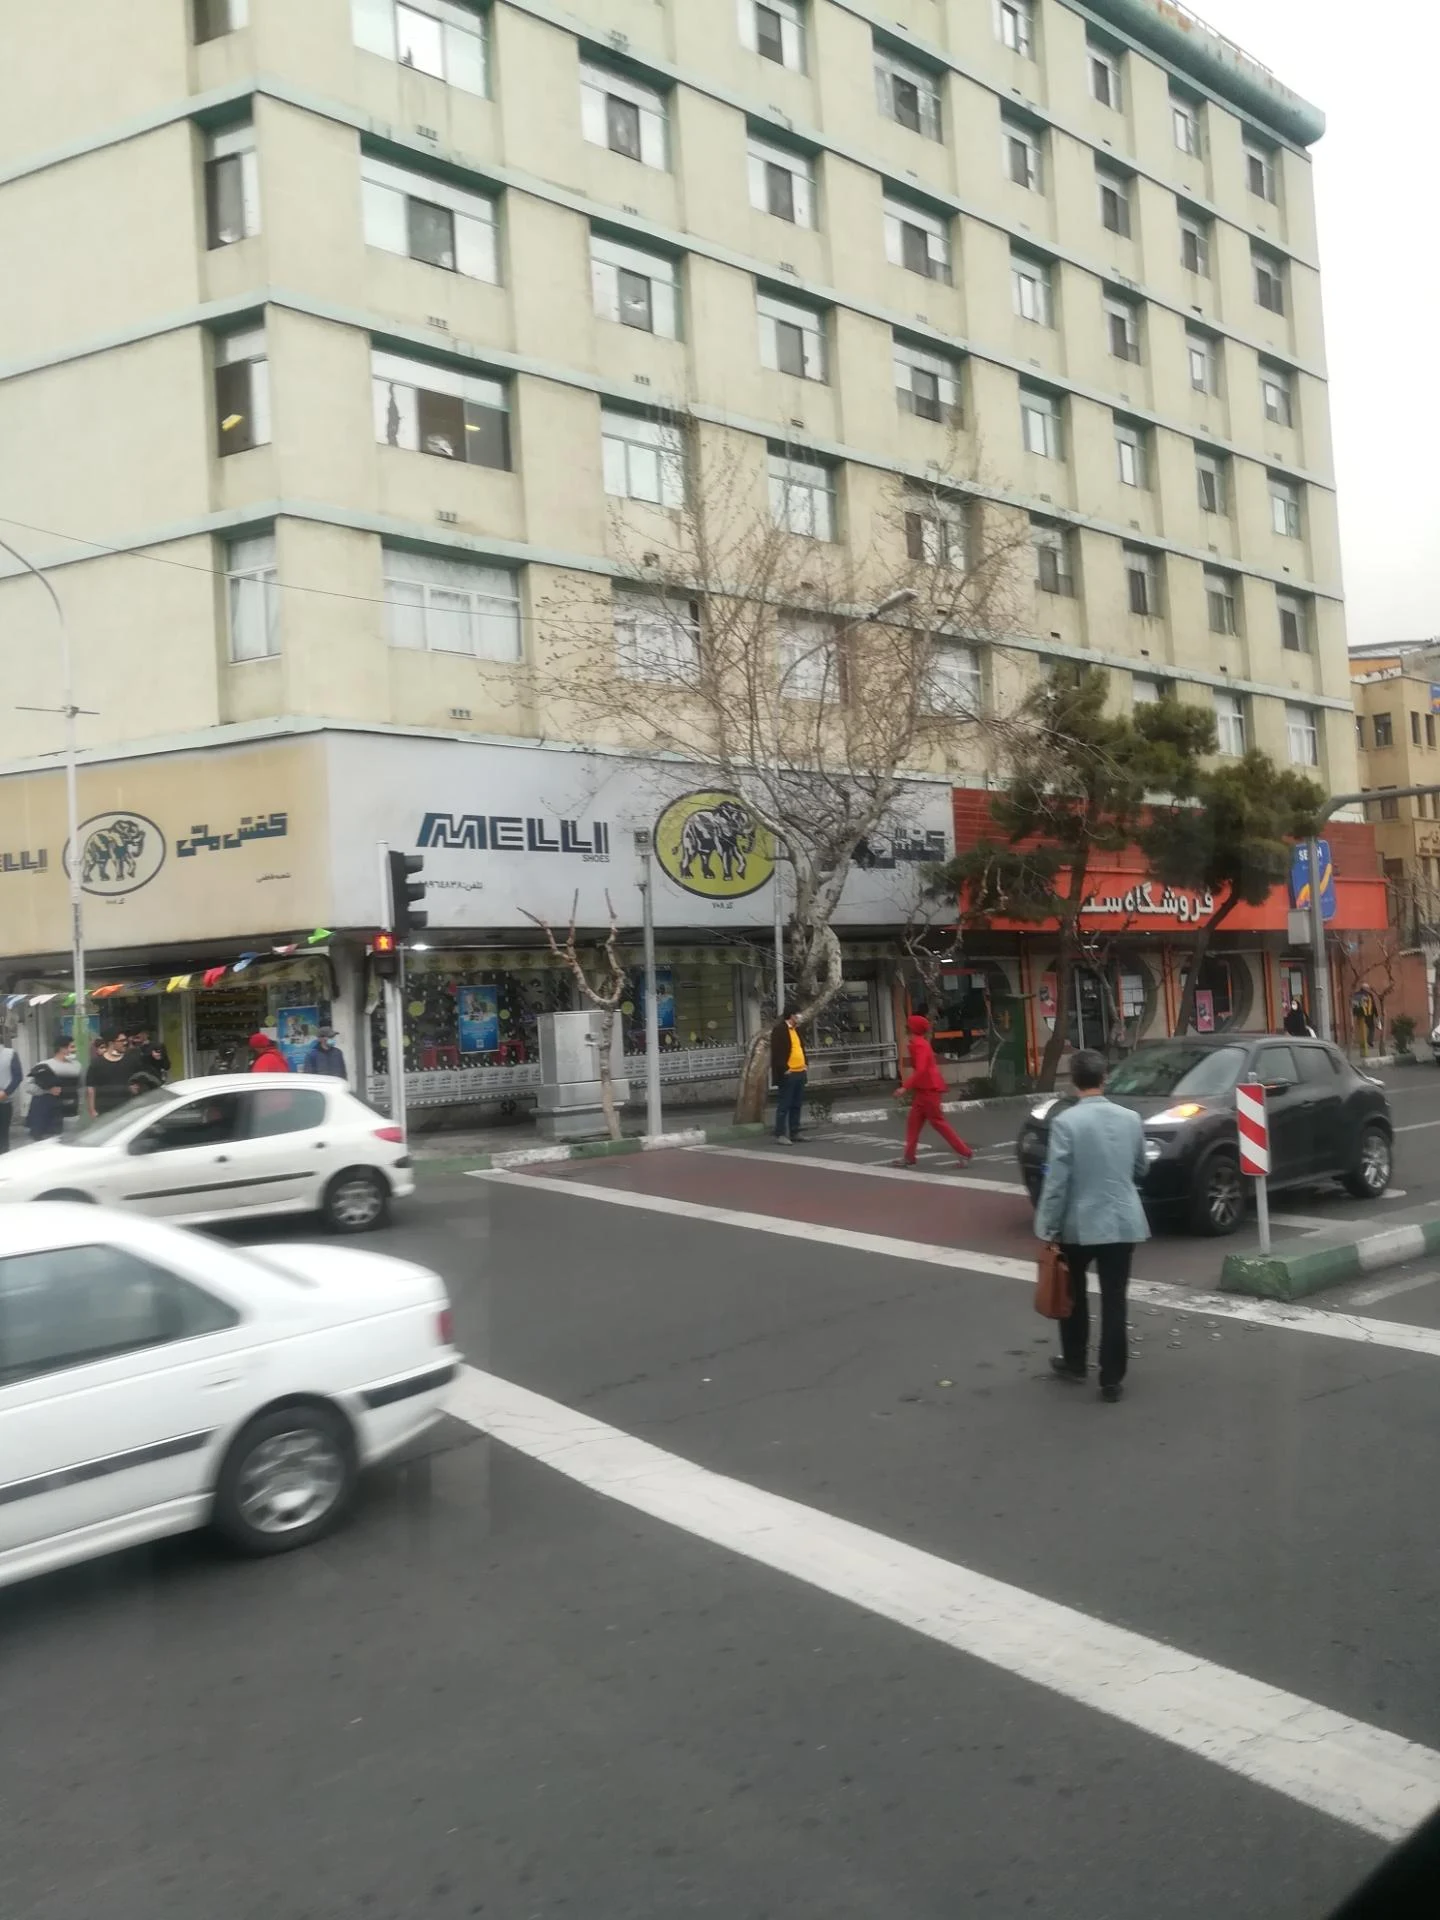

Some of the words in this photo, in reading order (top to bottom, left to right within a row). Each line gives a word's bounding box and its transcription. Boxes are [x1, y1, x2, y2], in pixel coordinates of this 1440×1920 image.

[176, 824, 221, 858] ملی
[223, 812, 288, 849] کفش
[416, 812, 609, 854] MELLI
[0, 848, 49, 872] LLI
[582, 854, 610, 863] SHOES
[1298, 846, 1323, 861] SEH
[1125, 881, 1215, 922] فروشگاه
